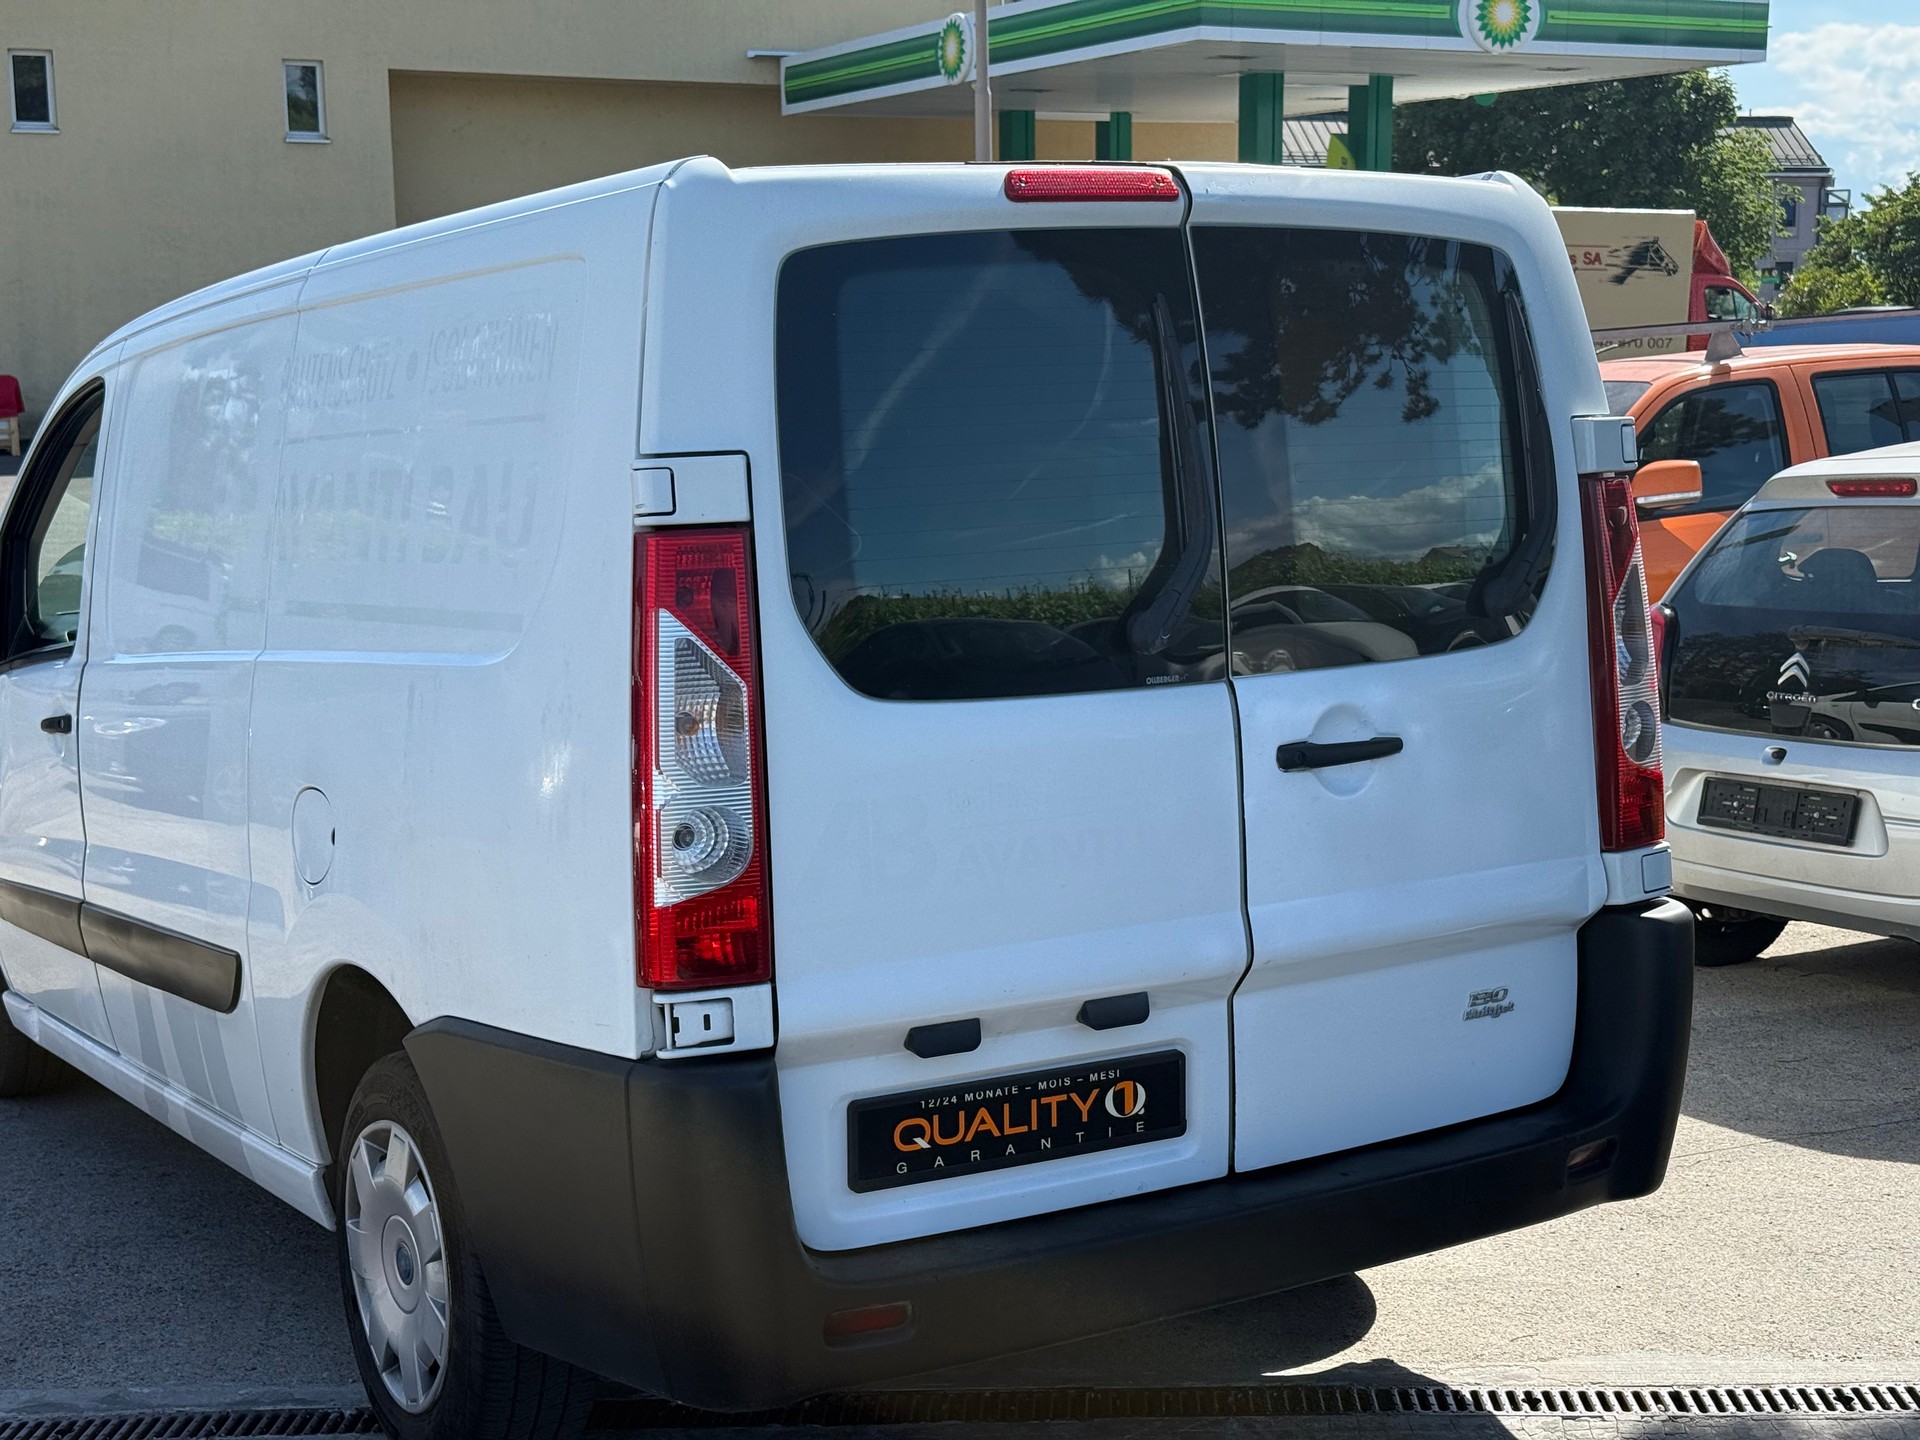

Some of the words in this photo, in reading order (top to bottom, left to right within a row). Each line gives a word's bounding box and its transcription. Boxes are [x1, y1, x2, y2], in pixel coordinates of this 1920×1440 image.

[1582, 251, 1602, 265] SA
[1647, 337, 1673, 349] 007
[920, 1096, 957, 1109] 12/24
[964, 1085, 1019, 1102] MONATE
[1038, 1077, 1071, 1090] MOIS
[1089, 1069, 1120, 1082] MESI
[893, 1088, 1099, 1152] QUALITY
[896, 1120, 1145, 1174] GARANTIE
